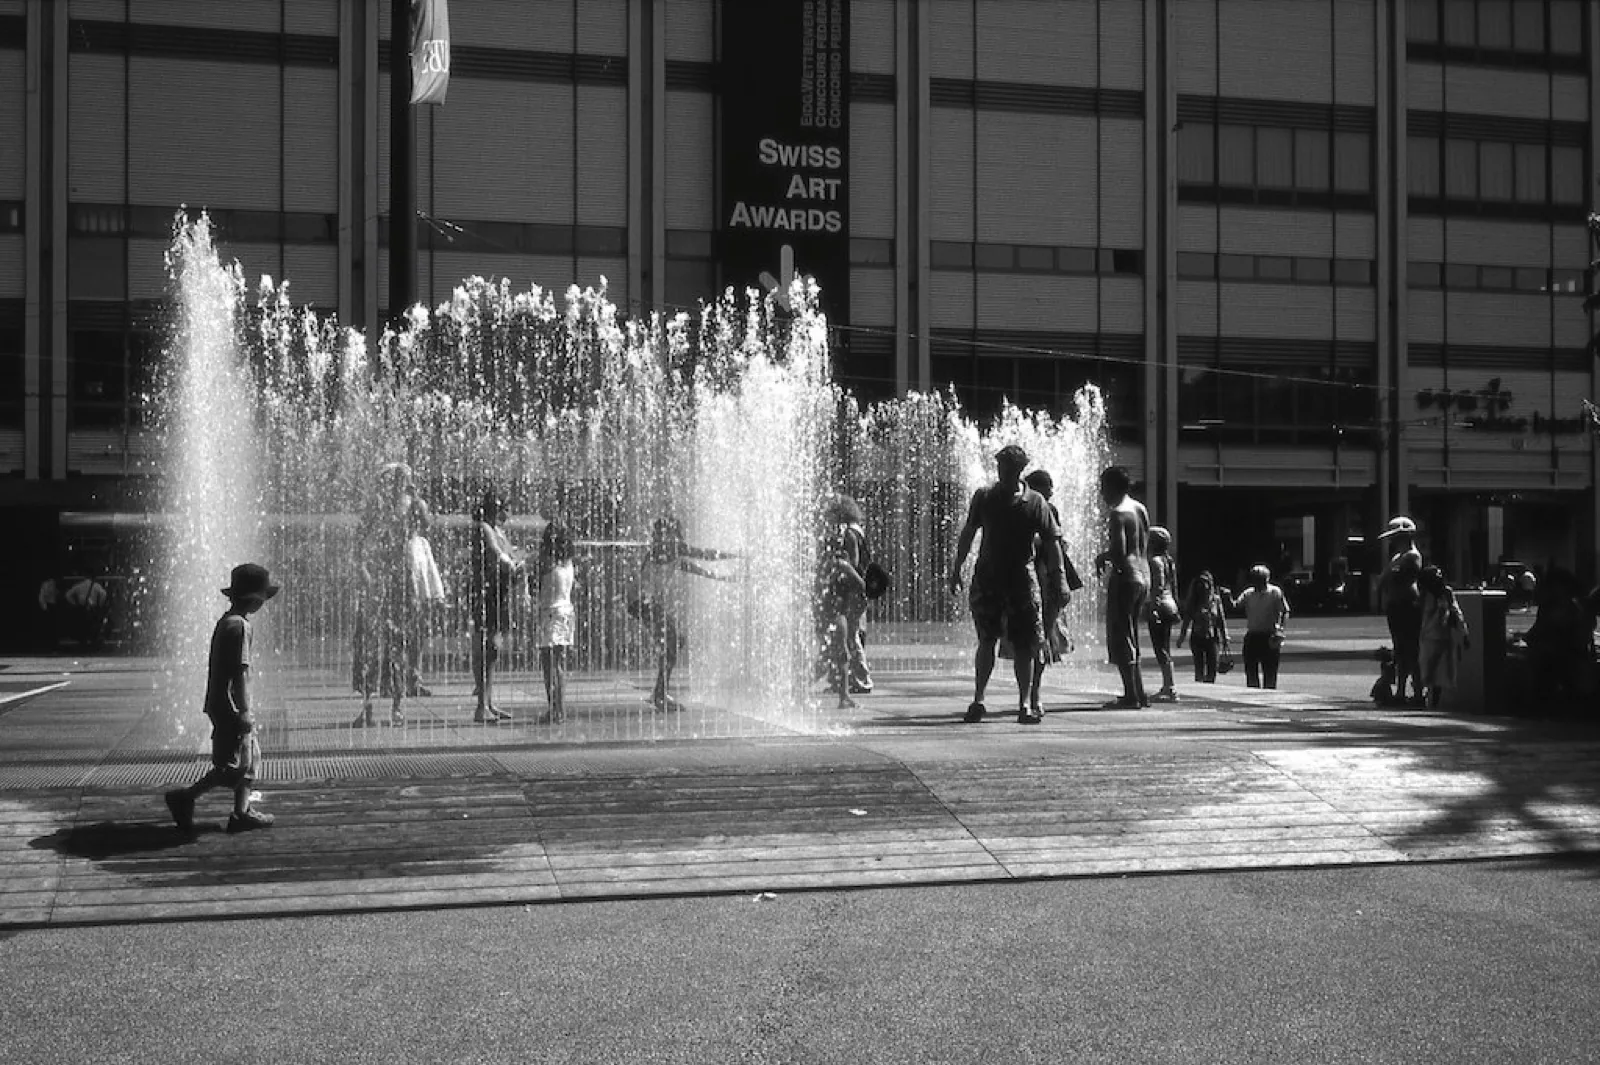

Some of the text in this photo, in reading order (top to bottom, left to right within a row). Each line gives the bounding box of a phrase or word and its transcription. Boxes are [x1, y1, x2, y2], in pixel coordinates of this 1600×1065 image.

[814, 52, 827, 127] CONCOURS
[828, 52, 841, 128] CONCORSO
[758, 138, 841, 169] SWISS
[786, 174, 842, 200] ART
[730, 202, 842, 233] AWARDS
